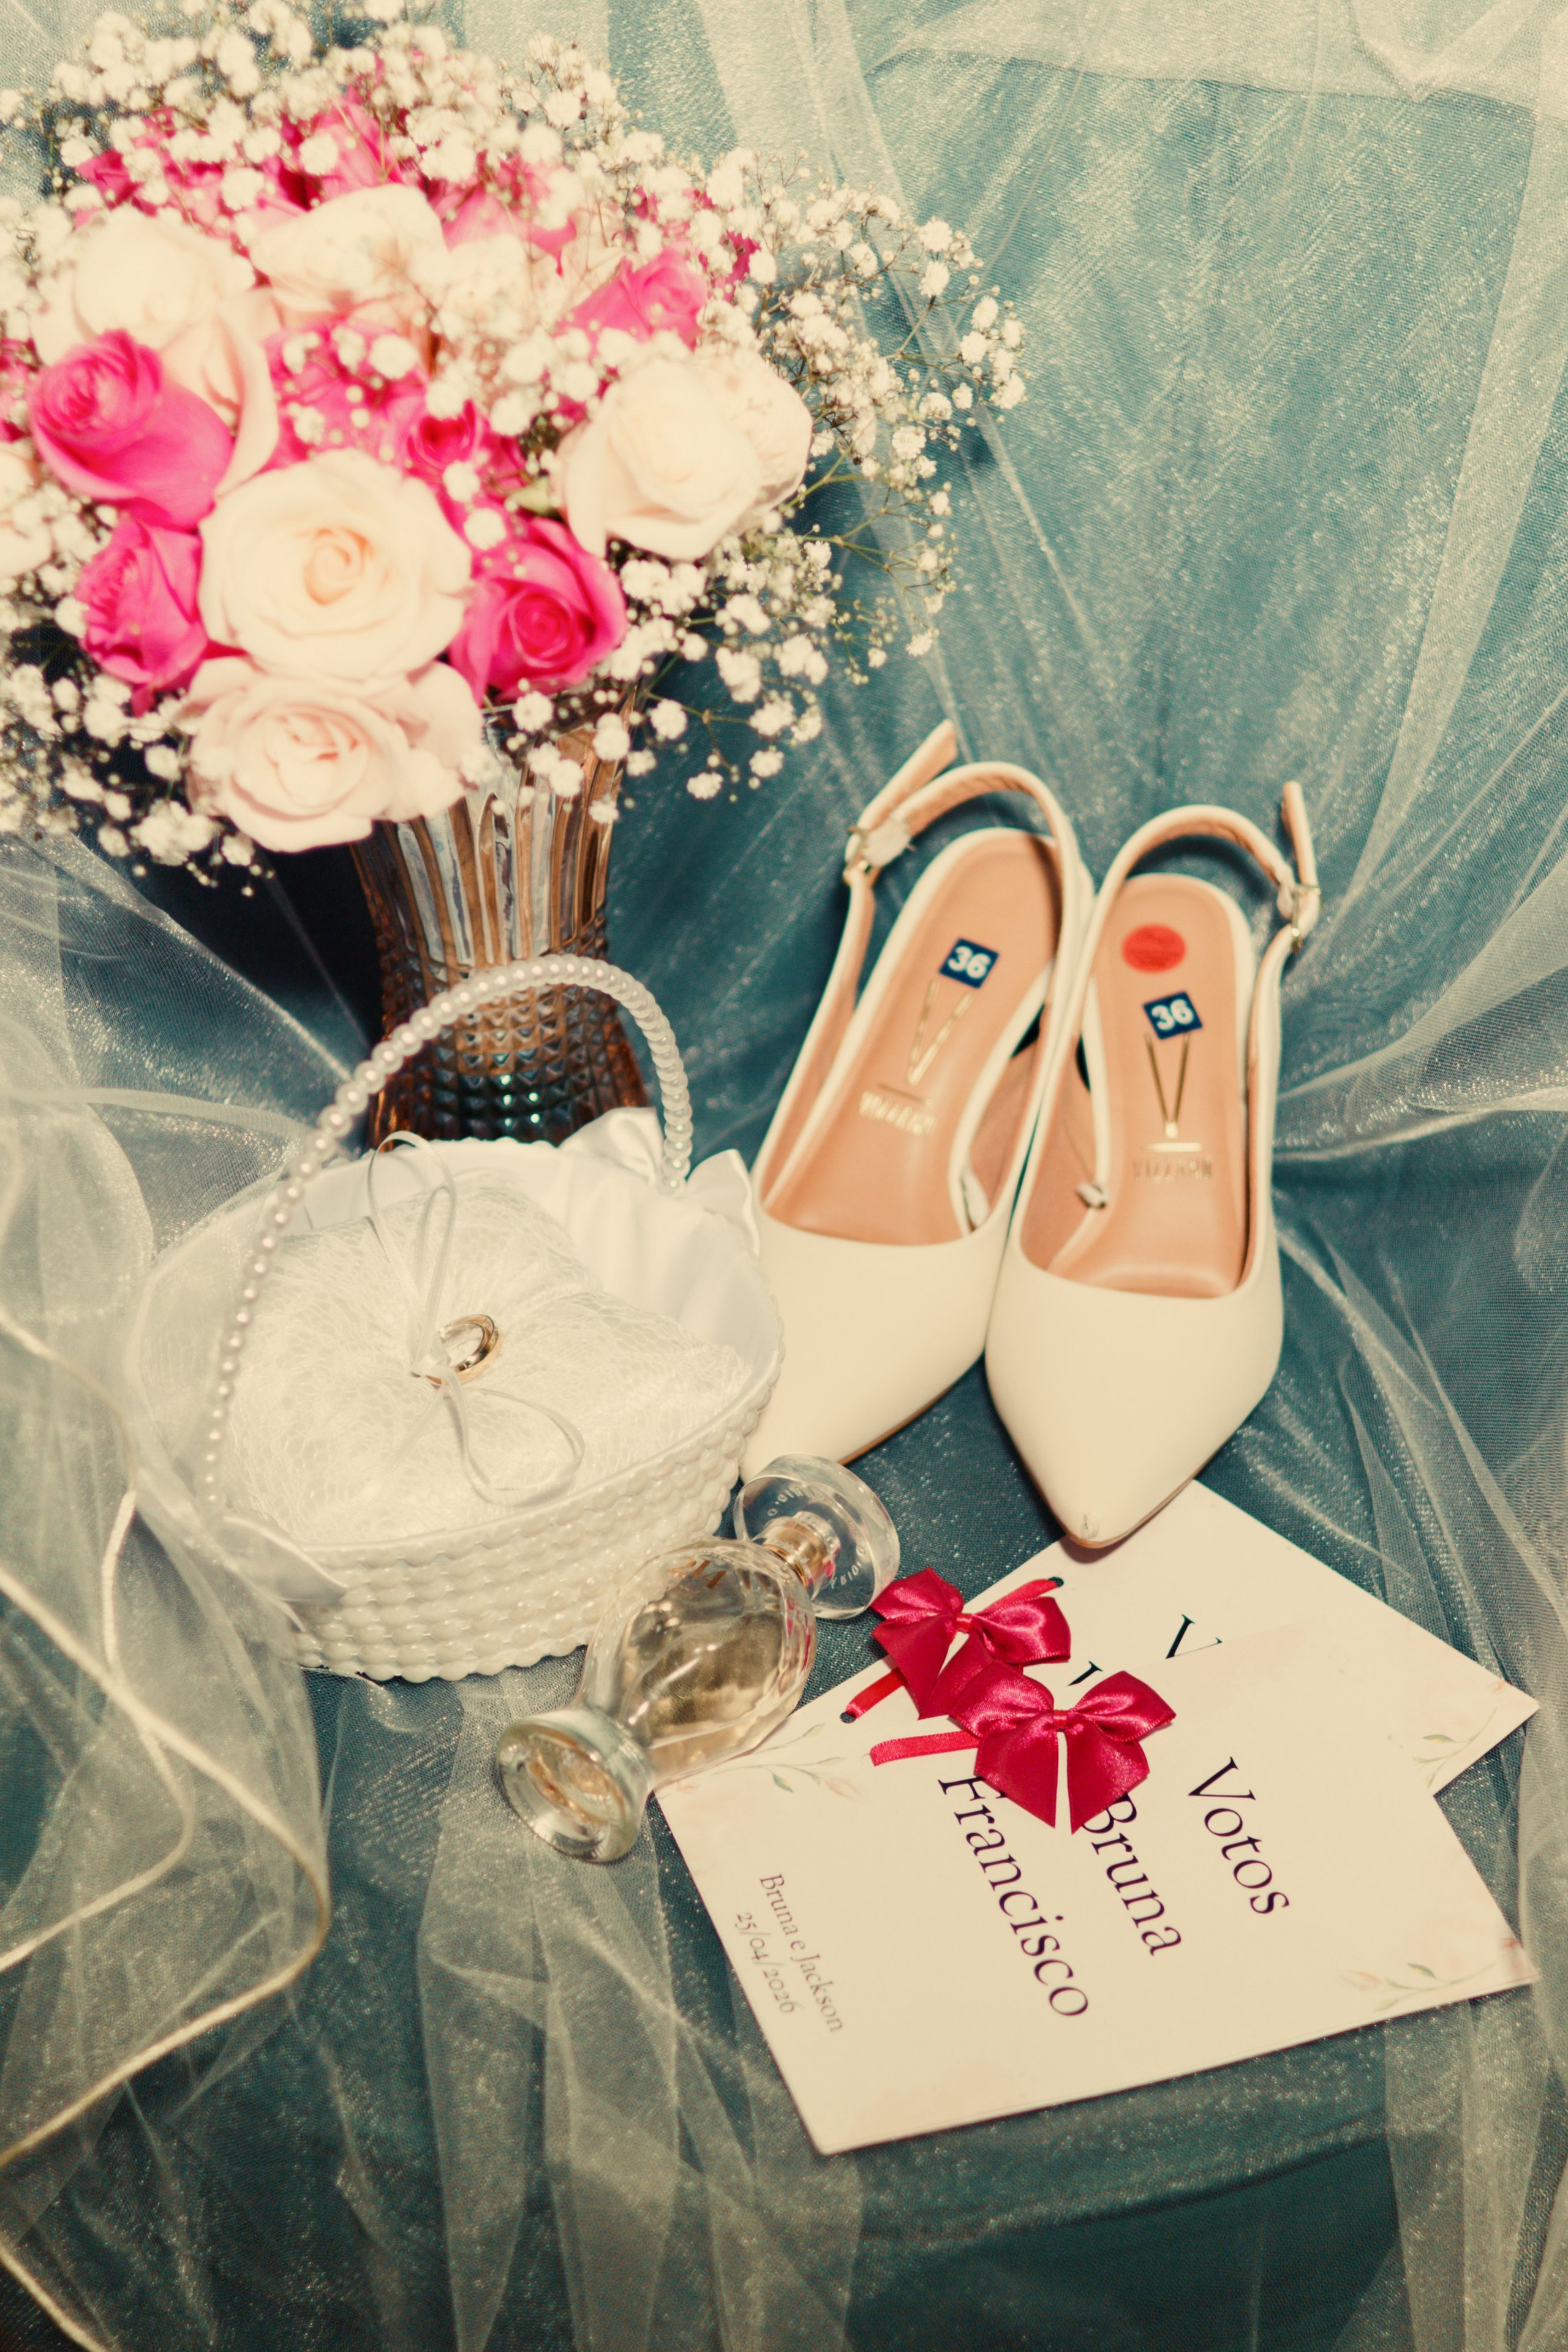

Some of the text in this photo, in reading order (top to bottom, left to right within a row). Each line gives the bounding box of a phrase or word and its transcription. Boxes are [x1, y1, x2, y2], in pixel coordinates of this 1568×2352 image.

[948, 946, 991, 978] 36
[1152, 998, 1194, 1031] 36
[667, 1556, 726, 1591] 214
[937, 1776, 1088, 2016] Francisco
[1081, 1792, 1182, 1956] Bruna
[1188, 1757, 1290, 1914] Votos
[735, 1912, 804, 2013] 25/04/2026
[760, 1873, 843, 2032] Bruna e Jackson
